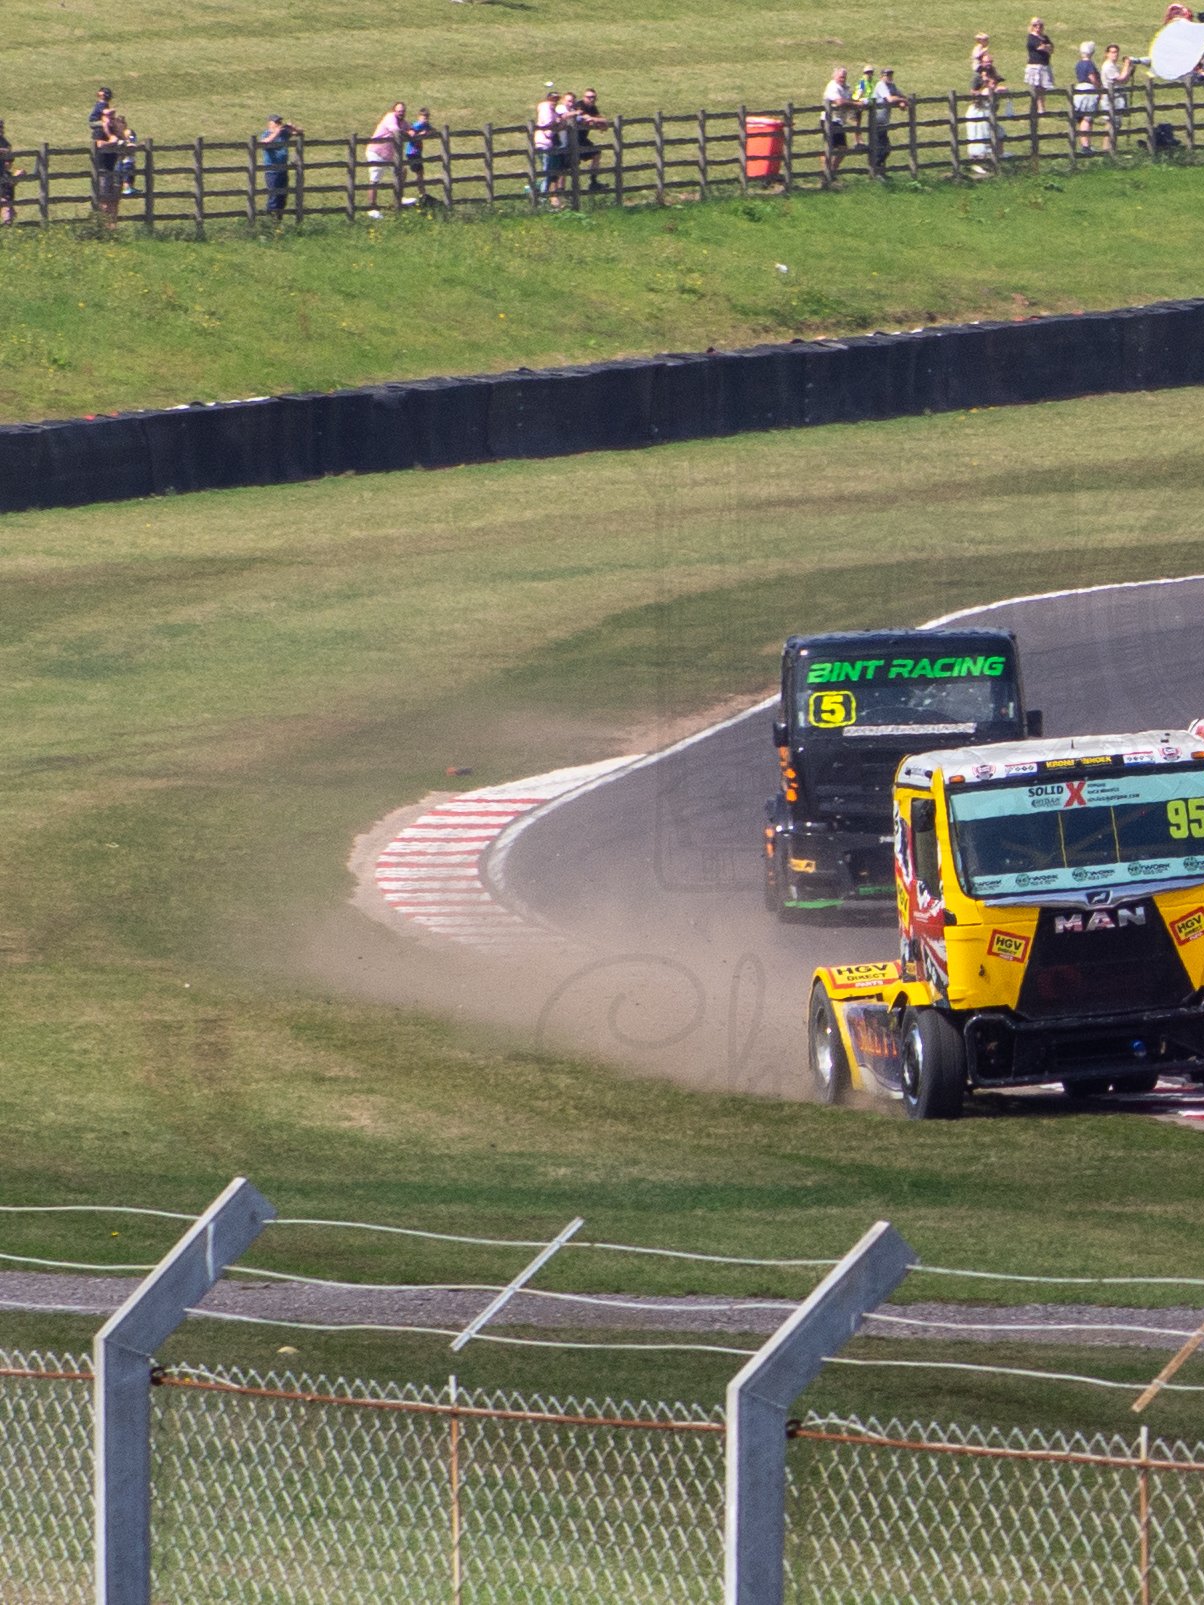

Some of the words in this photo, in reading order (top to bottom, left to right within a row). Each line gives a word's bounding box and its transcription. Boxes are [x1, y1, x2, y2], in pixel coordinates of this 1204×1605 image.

[807, 660, 884, 683] BINT
[888, 656, 1006, 679] RACING
[820, 695, 846, 723] 5
[1028, 785, 1064, 798] SOLID
[1063, 780, 1087, 808] X
[1055, 906, 1147, 934] MAN
[1176, 914, 1202, 935] HGV
[996, 936, 1024, 951] HGV
[836, 963, 888, 976] HGV
[846, 972, 887, 981] DIRECT
